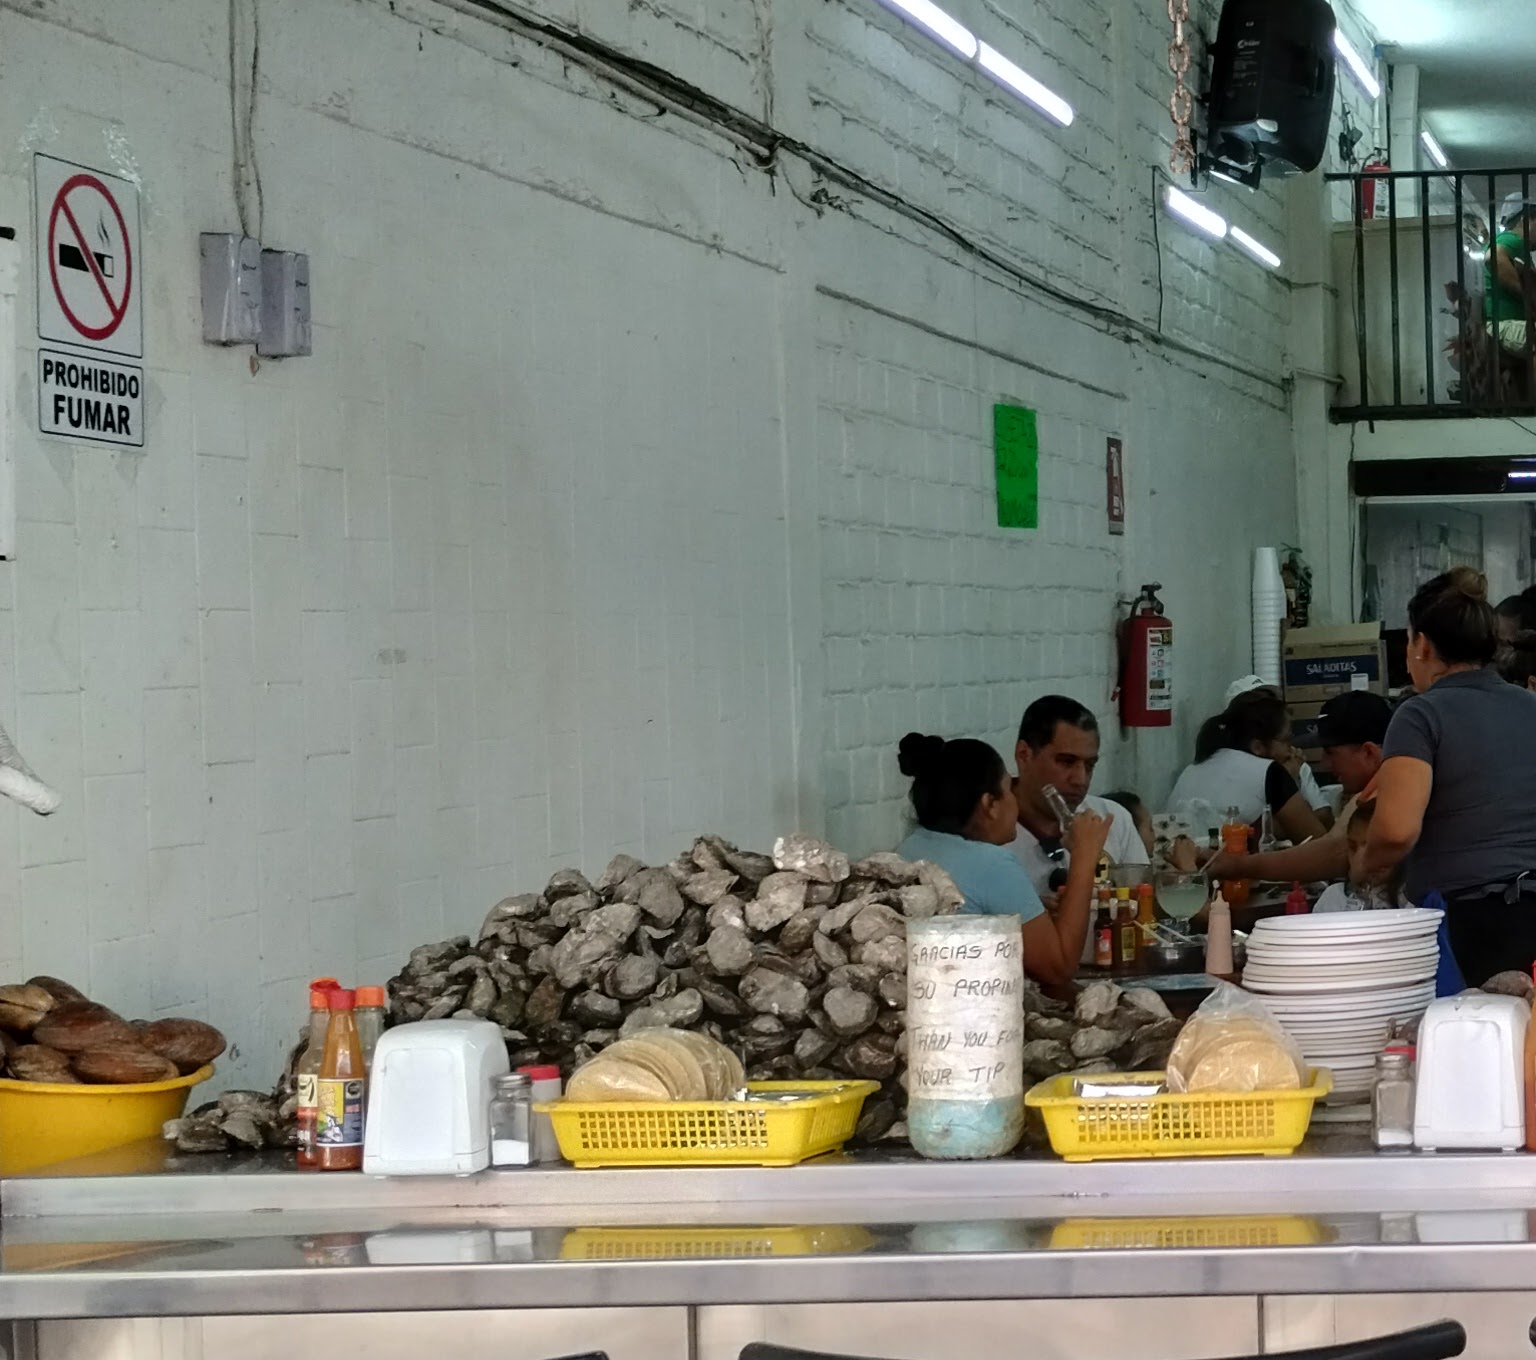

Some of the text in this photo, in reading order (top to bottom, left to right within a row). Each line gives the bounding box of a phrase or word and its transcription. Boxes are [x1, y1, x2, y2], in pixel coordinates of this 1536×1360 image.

[43, 358, 140, 400] PROHIBIDO
[53, 394, 131, 436] FUMAR
[1306, 661, 1358, 675] SALADITAS
[912, 980, 937, 1000] SU
[963, 1030, 989, 1049] YOU
[915, 1061, 1006, 1087] YOUR TIP
